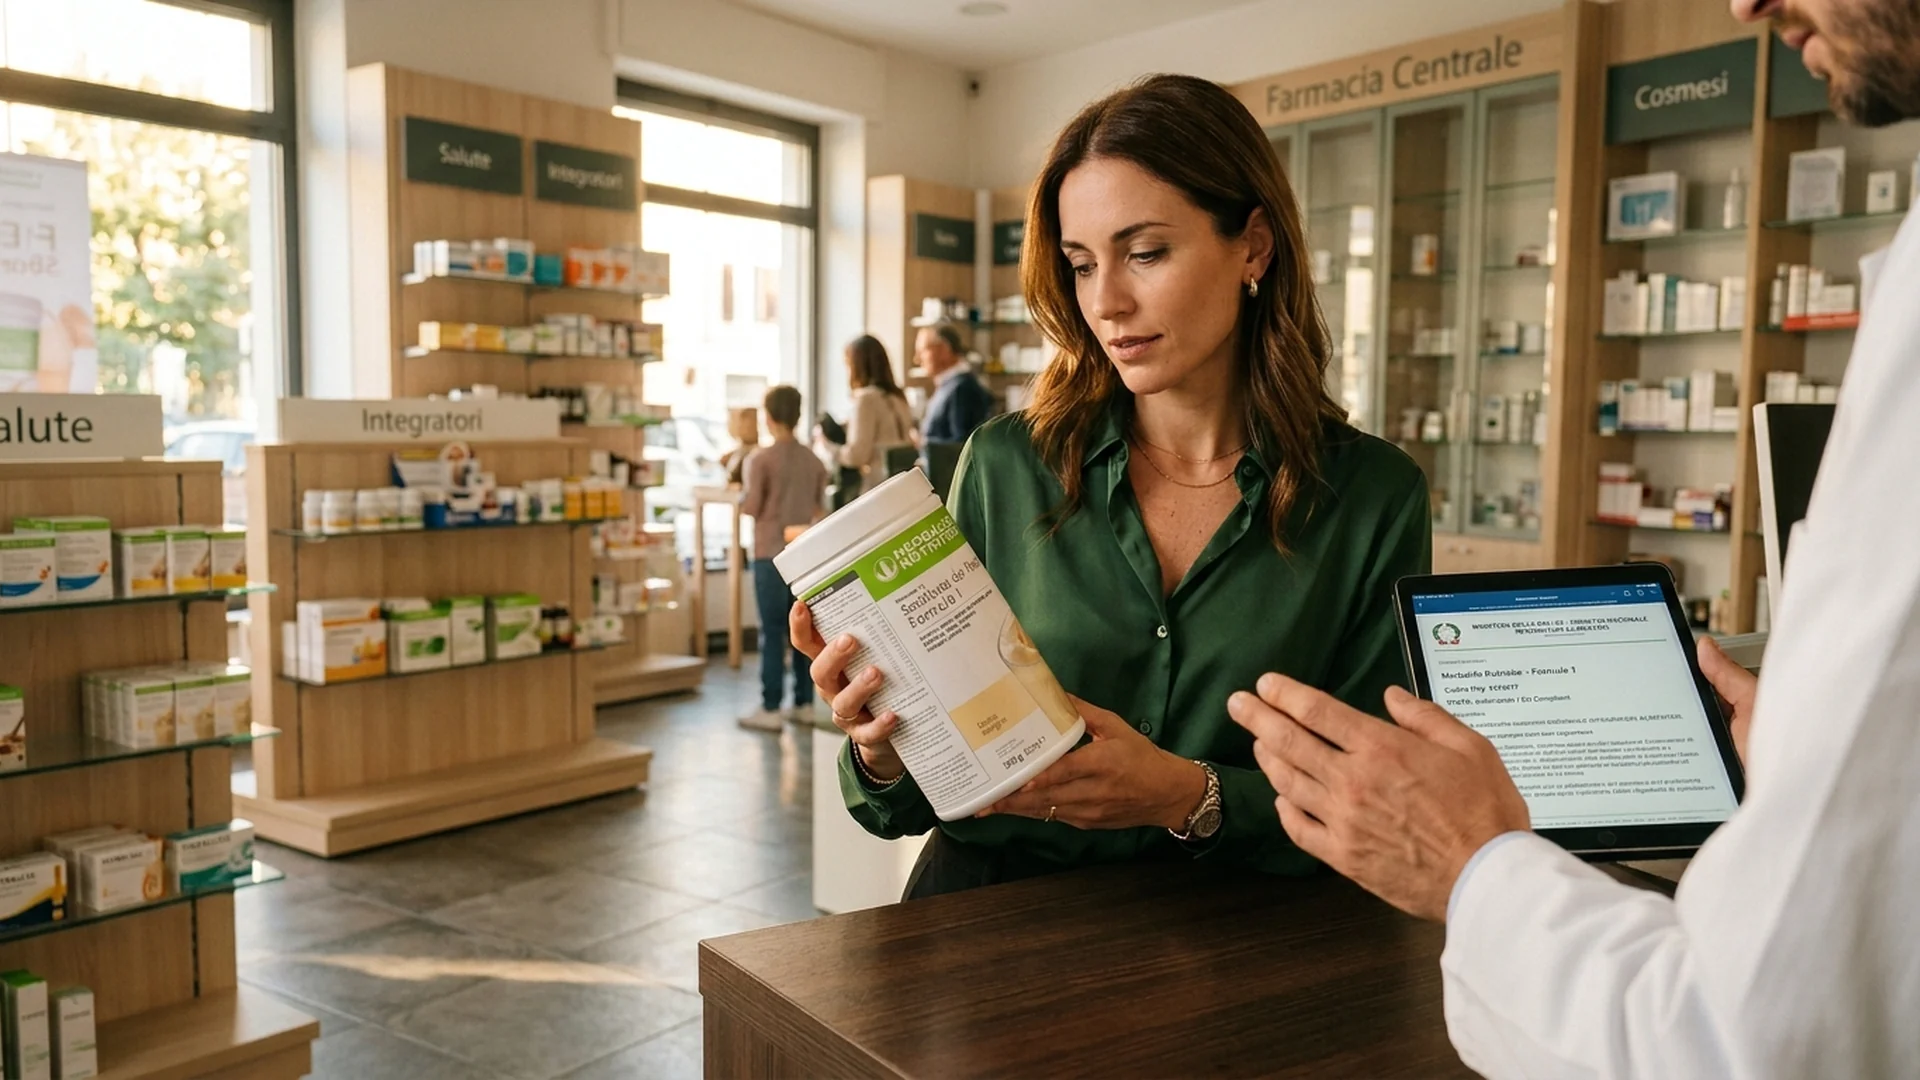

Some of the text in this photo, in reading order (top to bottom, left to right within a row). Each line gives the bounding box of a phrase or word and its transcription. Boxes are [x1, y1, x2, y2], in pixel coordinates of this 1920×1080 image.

[1266, 35, 1524, 115] Farmacia Centrale
[1634, 70, 1729, 111] Cosmesi
[438, 141, 492, 171] Salute
[547, 161, 623, 190] Integratori
[0, 405, 94, 444] alute
[362, 407, 483, 438] Integratori
